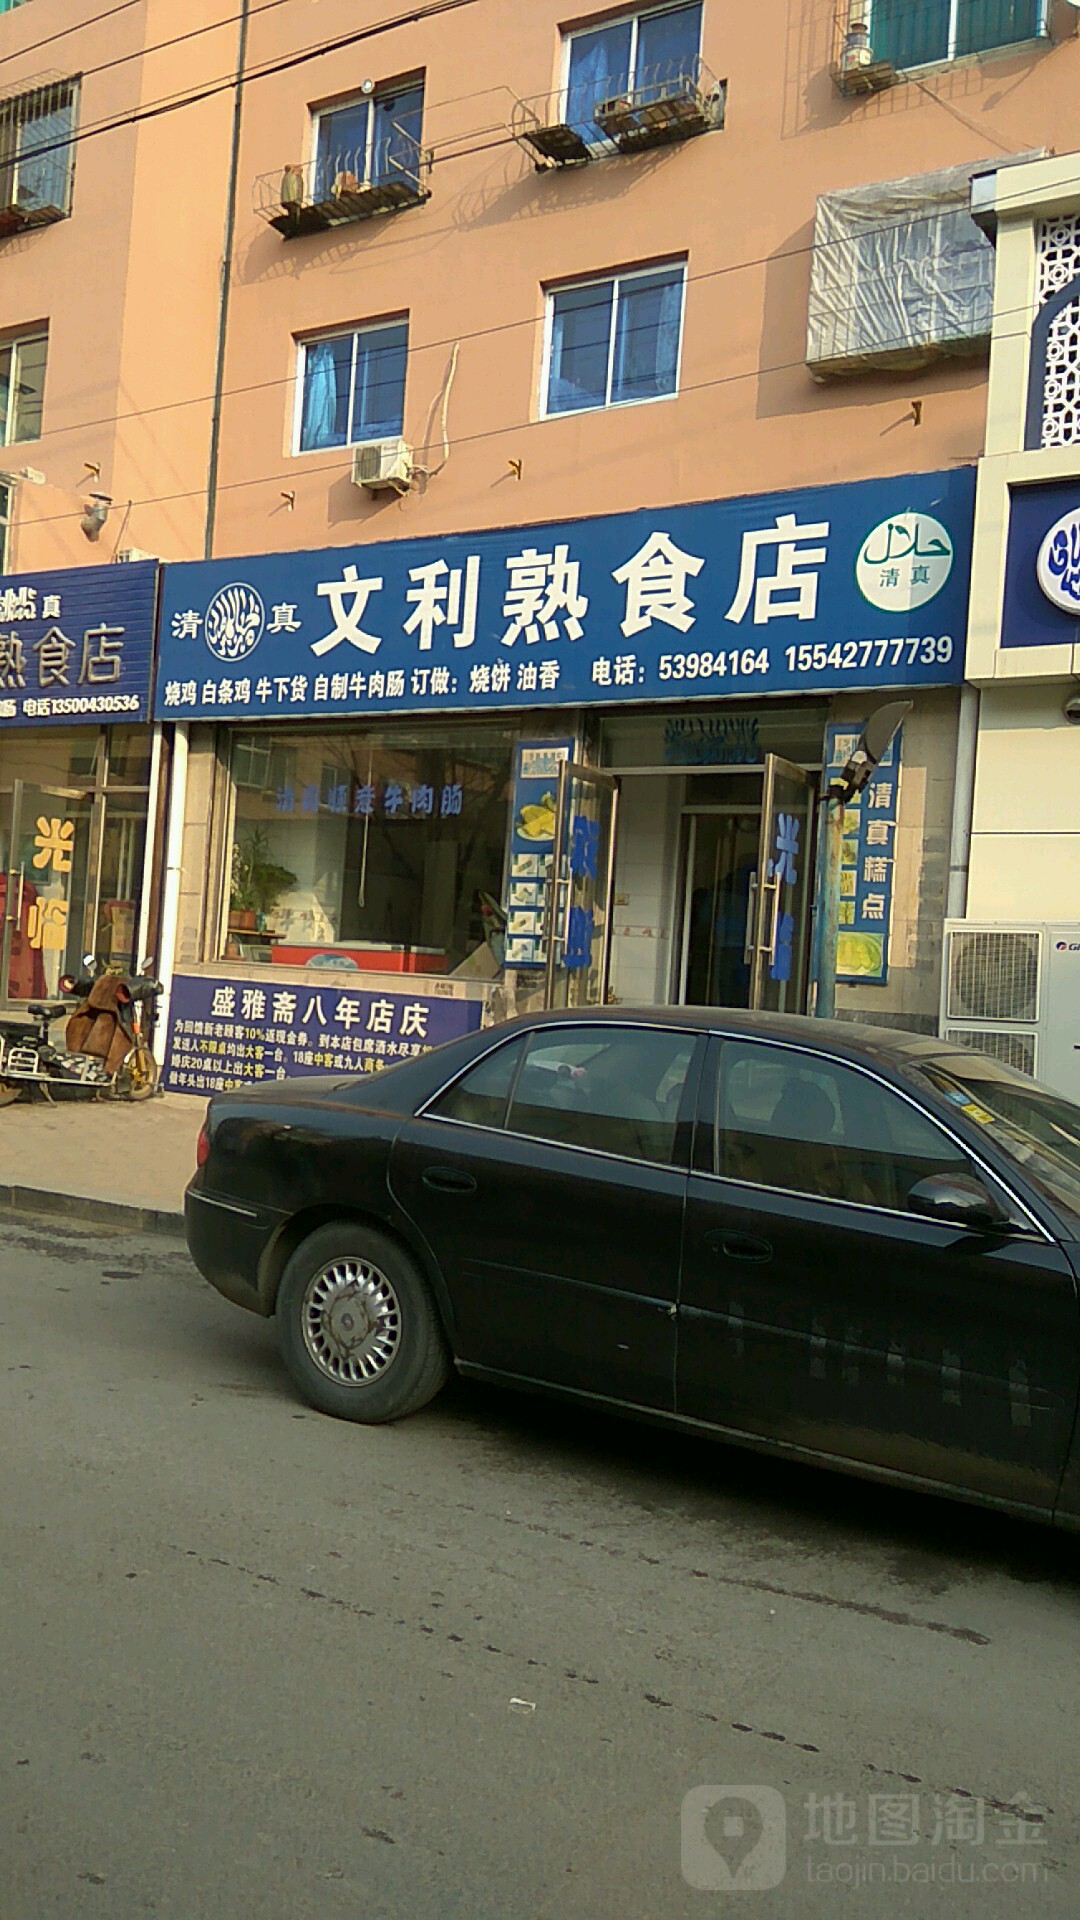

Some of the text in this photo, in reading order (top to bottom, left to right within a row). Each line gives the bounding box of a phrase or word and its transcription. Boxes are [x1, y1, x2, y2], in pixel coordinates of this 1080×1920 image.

[42, 594, 61, 619] 真
[310, 513, 830, 658] 文利熟食店
[879, 564, 931, 587] 清真
[163, 679, 197, 706] 烧鸡
[201, 677, 251, 705] 白条鸡
[255, 675, 308, 704] 牛下货
[313, 669, 405, 701] 自制牛肉肠
[468, 659, 512, 694] 烧饼
[516, 659, 561, 691] 油香
[658, 646, 770, 679] 53984164
[785, 636, 953, 673] 15542777739
[861, 782, 894, 921] 清真糕点
[210, 985, 431, 1039] 盛雅斋八年店庆
